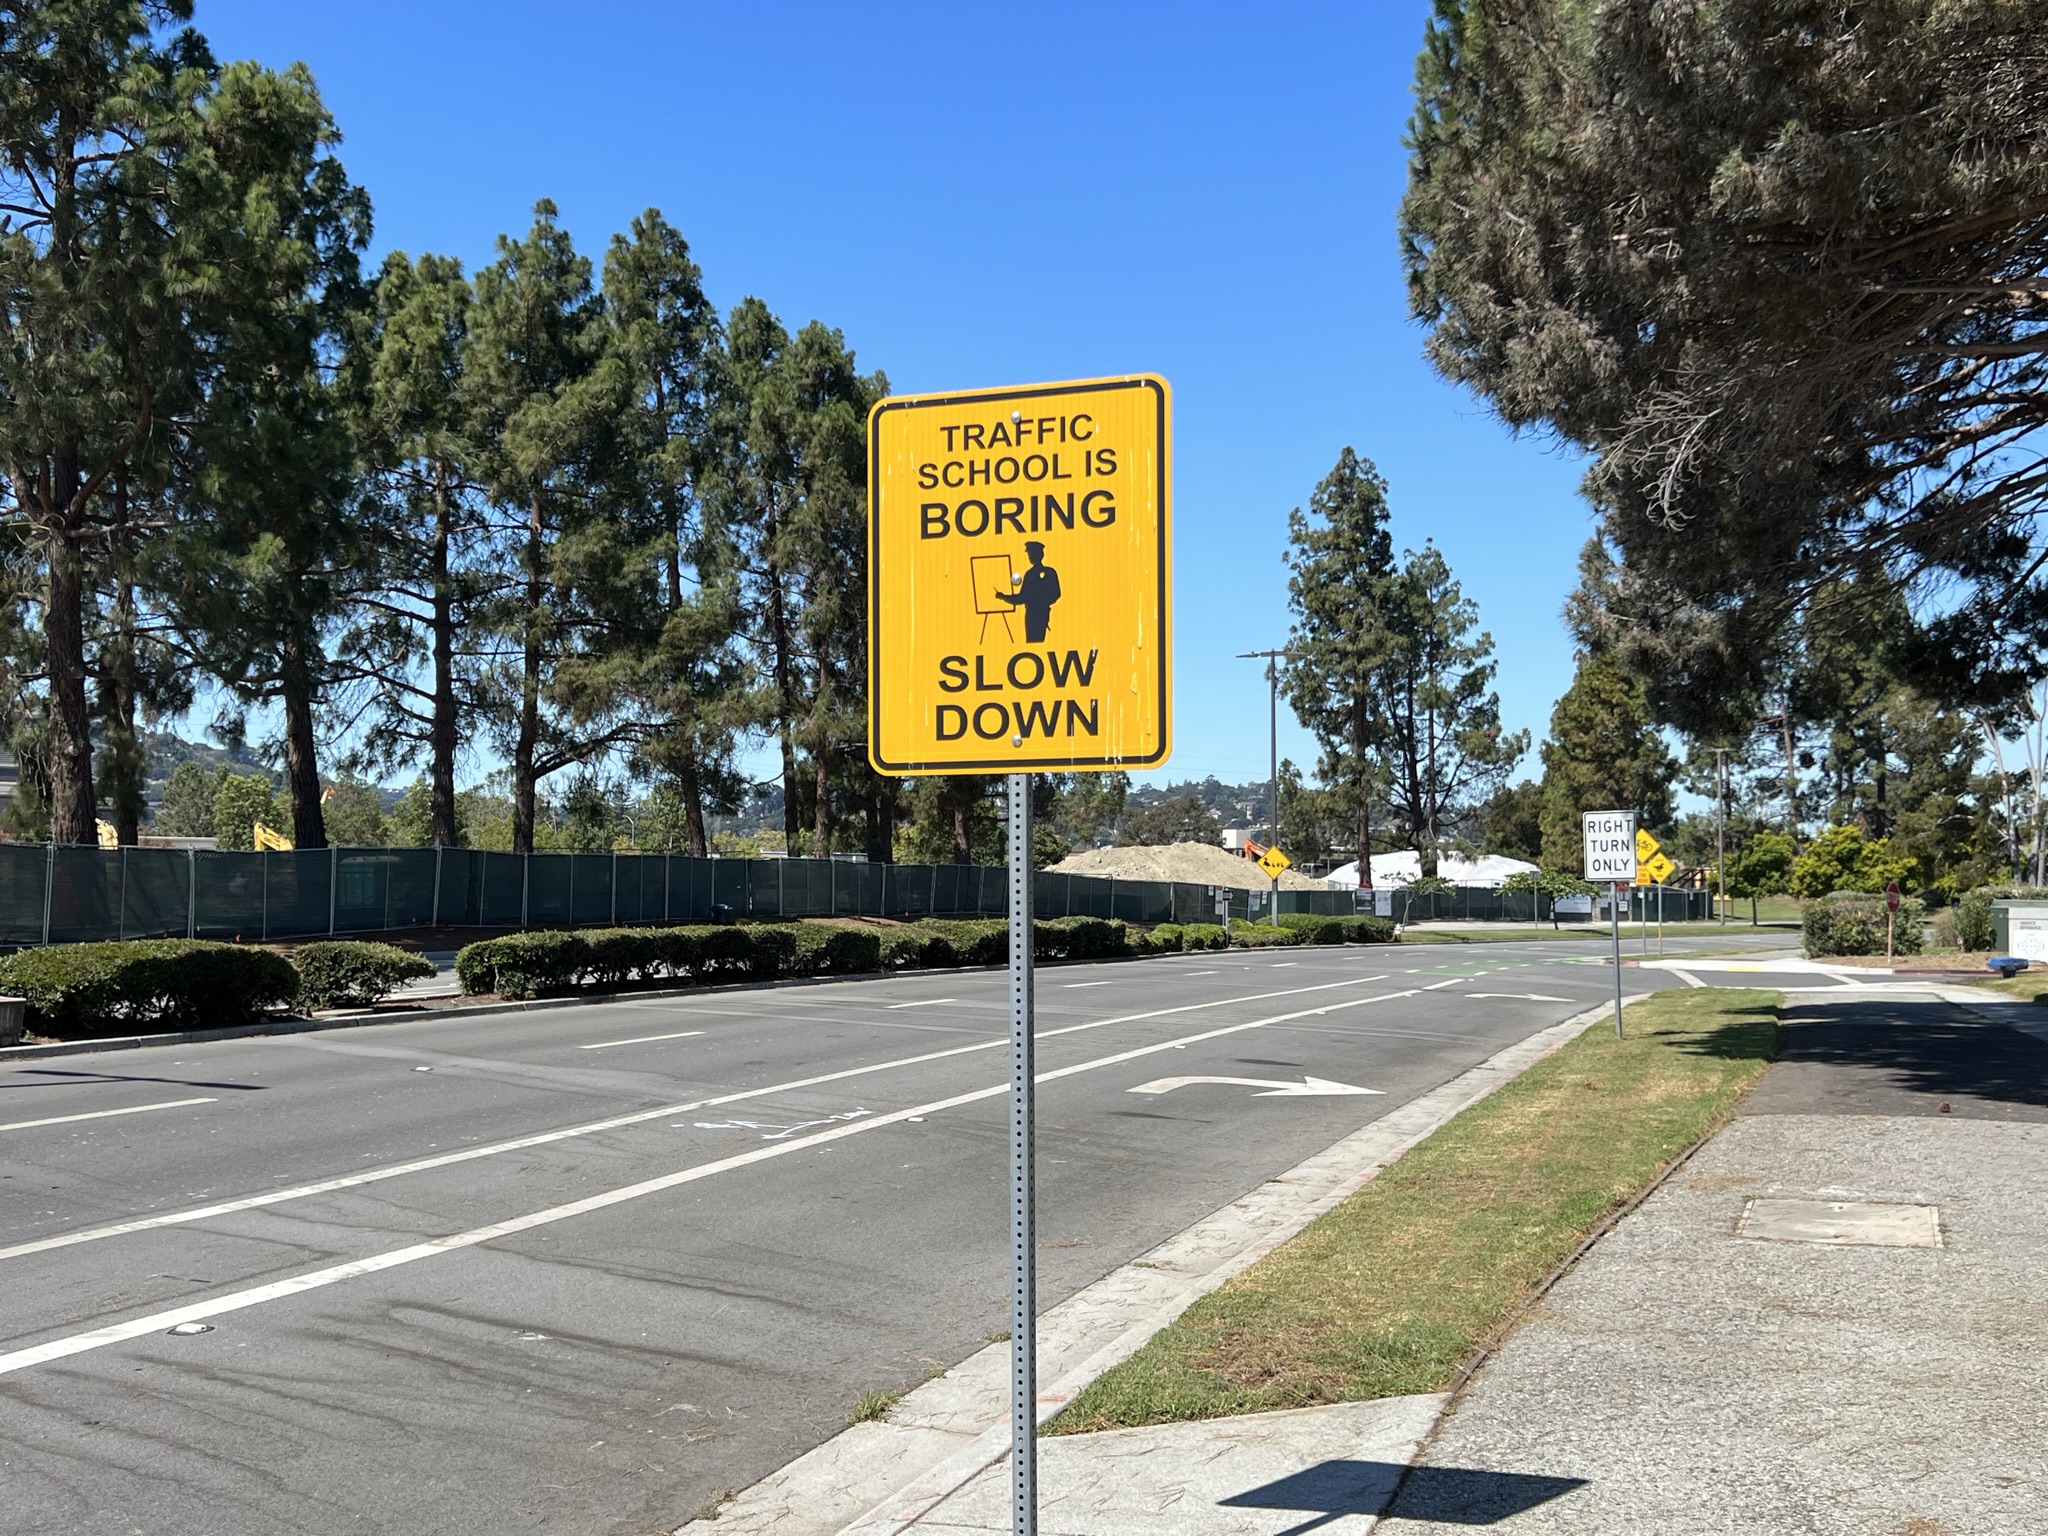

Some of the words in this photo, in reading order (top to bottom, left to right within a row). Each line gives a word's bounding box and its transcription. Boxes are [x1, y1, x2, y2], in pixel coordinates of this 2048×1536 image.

[940, 414, 1093, 452] TRAFFIC
[918, 453, 1072, 490] SCHOOL
[1085, 448, 1117, 477] IS
[920, 489, 1116, 540] BORING
[938, 649, 1099, 693] SLOW
[936, 698, 1099, 741] DOWN
[1587, 819, 1633, 834] RIGHT
[1590, 839, 1630, 853] TURN
[1592, 858, 1630, 872] ONLY
